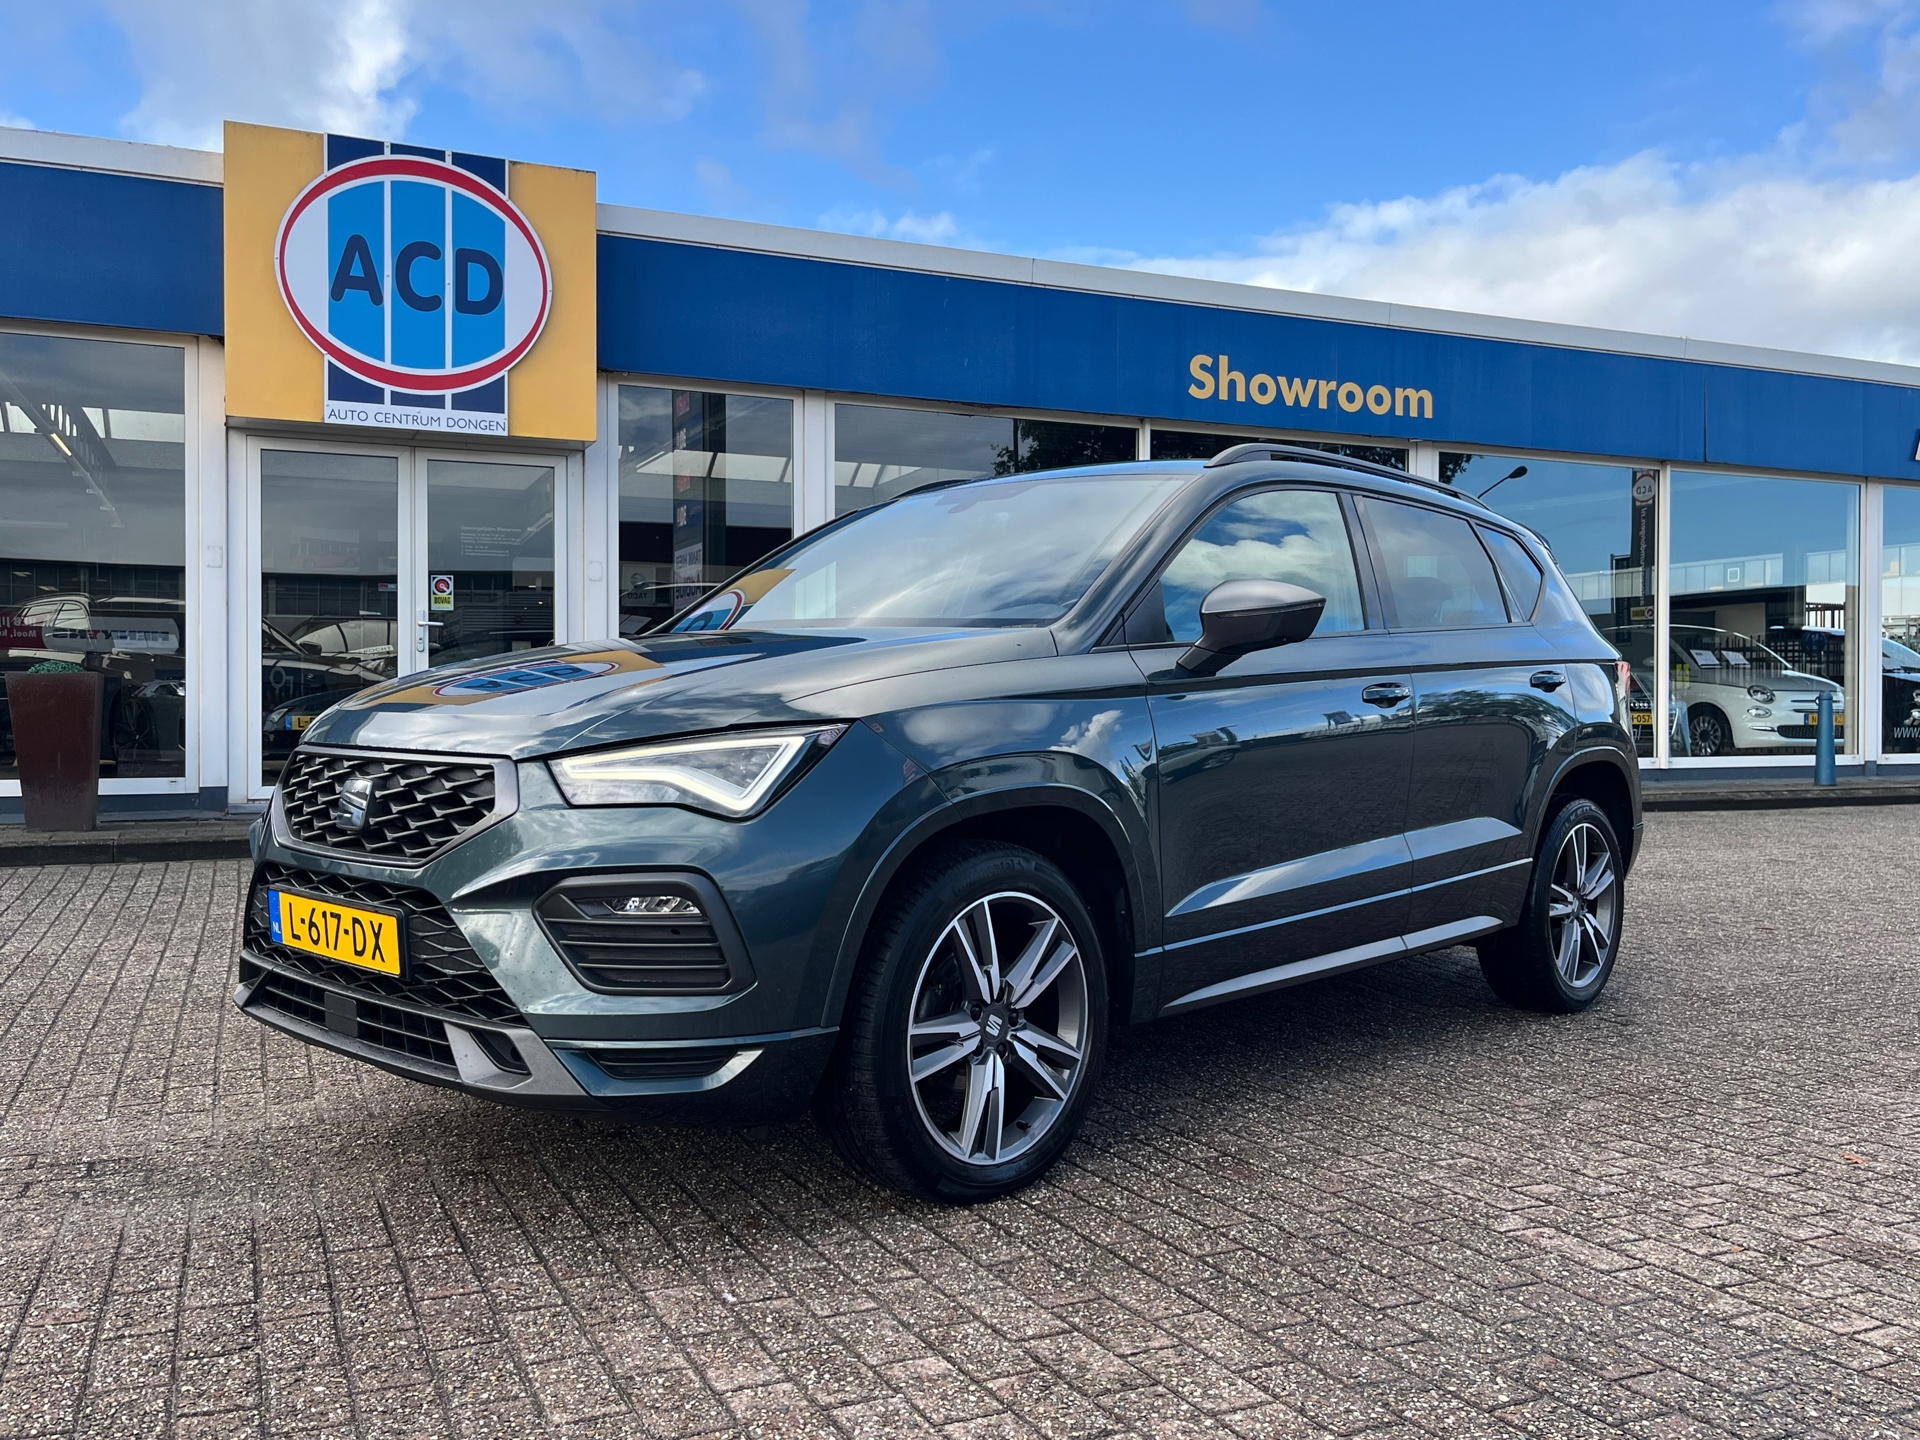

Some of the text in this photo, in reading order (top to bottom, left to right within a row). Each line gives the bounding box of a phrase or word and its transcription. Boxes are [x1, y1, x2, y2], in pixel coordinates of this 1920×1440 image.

[331, 234, 504, 315] ACD
[1188, 354, 1433, 419] Showroom
[328, 408, 506, 432] AUTO CENTRUM DONGEN
[272, 921, 281, 934] NL
[289, 902, 386, 963] L-617-DX
